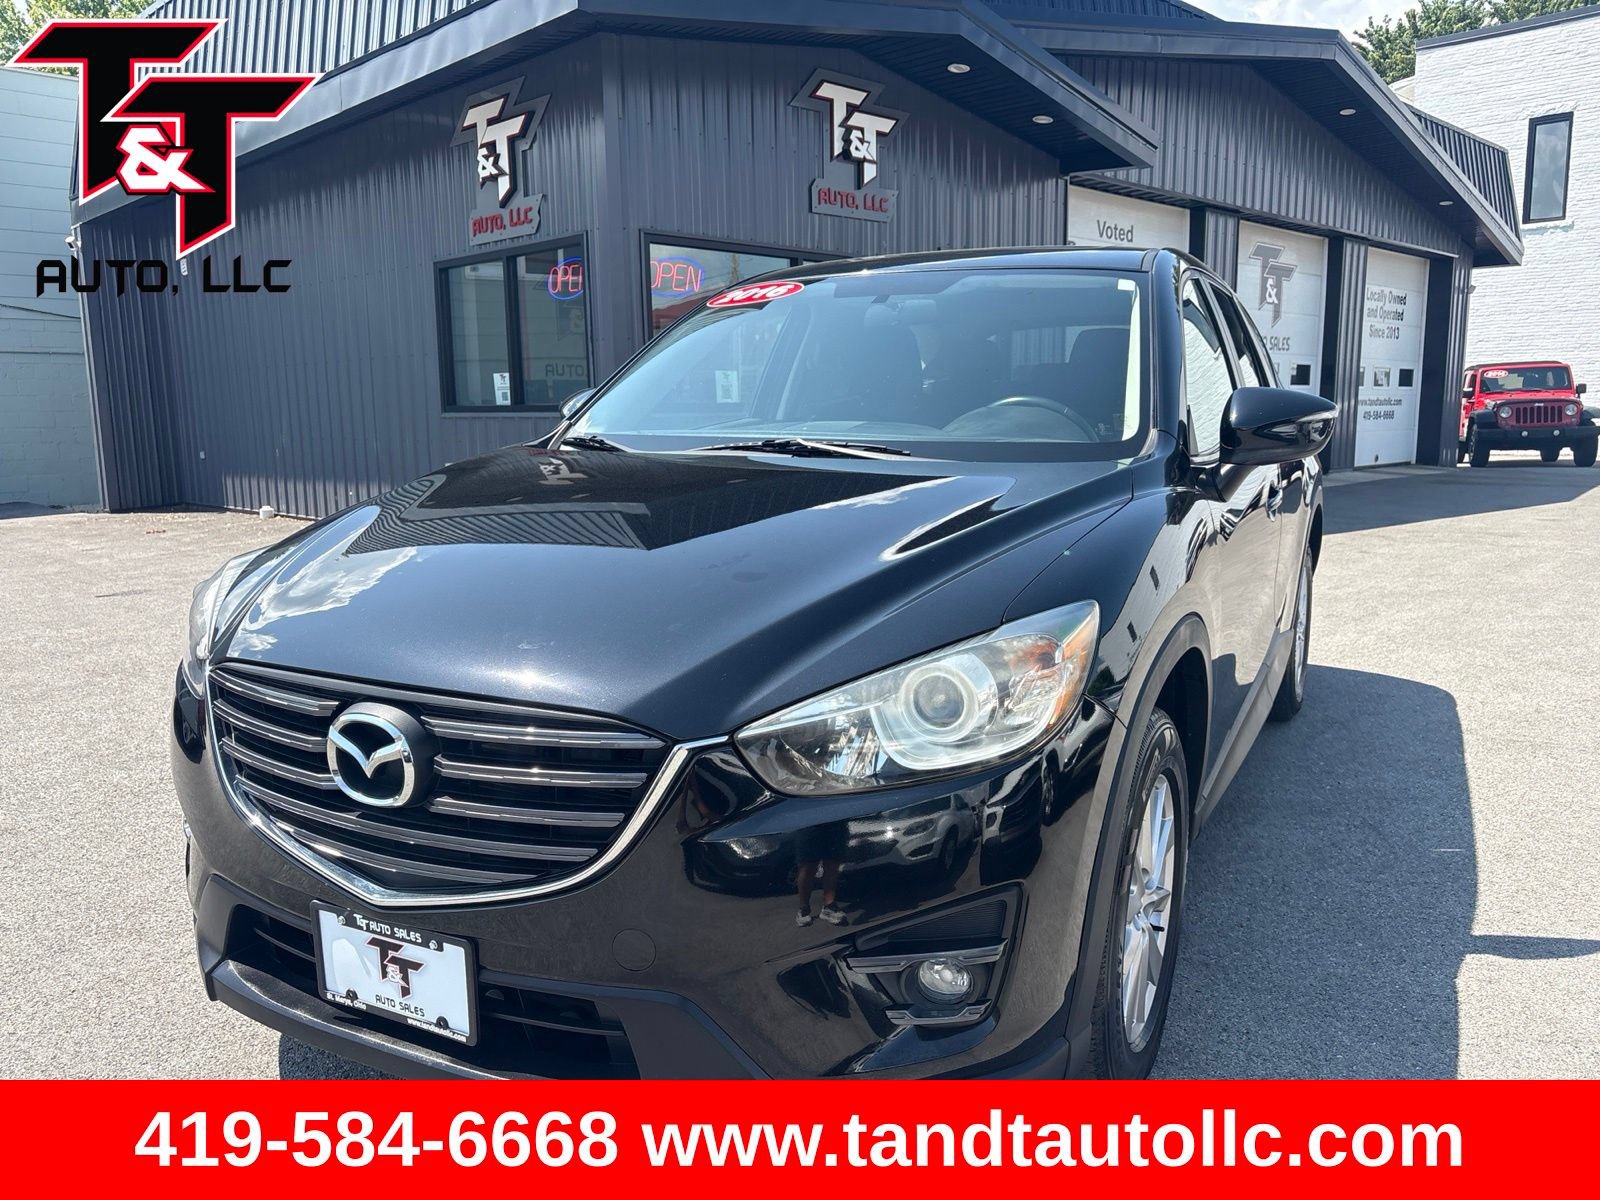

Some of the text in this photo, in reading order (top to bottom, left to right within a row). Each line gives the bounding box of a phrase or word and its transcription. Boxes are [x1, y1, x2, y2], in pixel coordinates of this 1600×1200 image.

[810, 80, 899, 187] T&T
[461, 96, 528, 202] T&T
[863, 193, 889, 213] LLC
[509, 206, 533, 227] LLC
[1096, 219, 1135, 243] Voted
[716, 283, 795, 305] 2016
[1248, 241, 1298, 329] T&T
[1367, 287, 1407, 306] Locally Owned
[1366, 305, 1404, 323] and Operated
[1369, 324, 1400, 340] Since 2013
[1269, 336, 1291, 352] SALES
[370, 920, 391, 935] AUTO
[394, 927, 422, 943] SALES
[364, 934, 426, 999] T&T
[375, 994, 425, 1017] AUTO SALES
